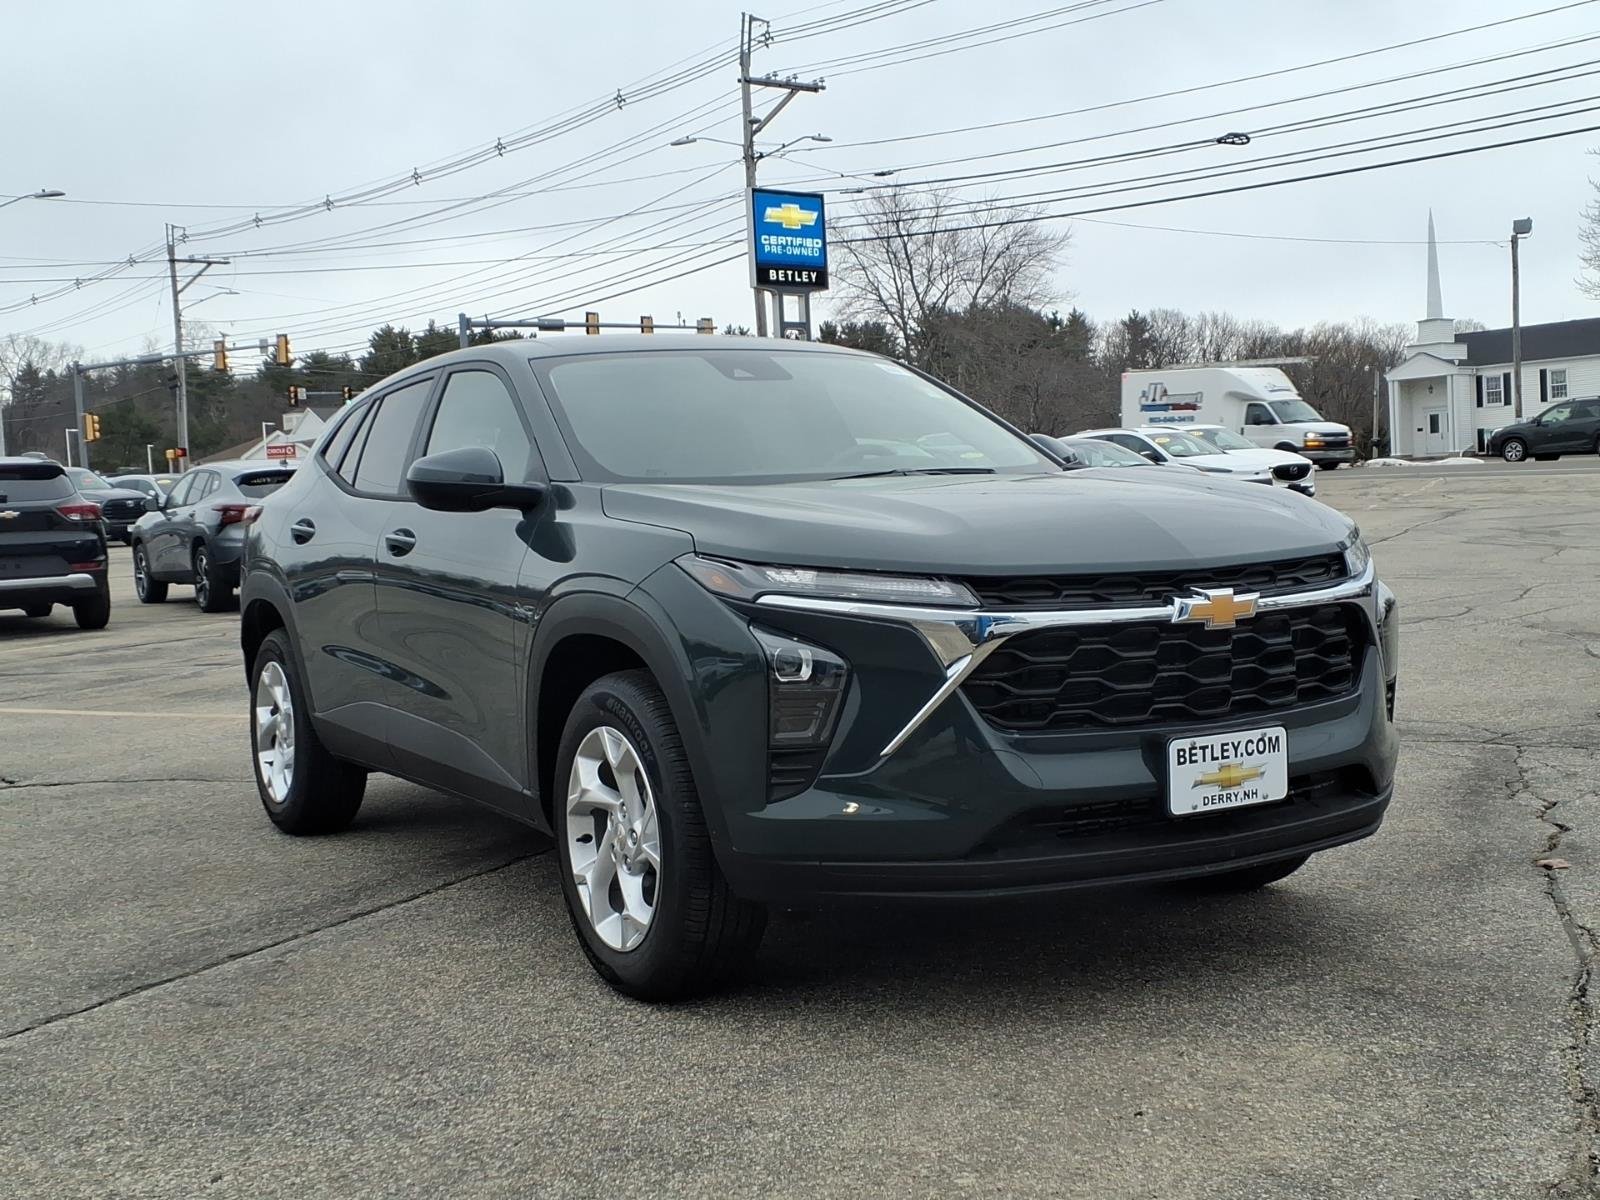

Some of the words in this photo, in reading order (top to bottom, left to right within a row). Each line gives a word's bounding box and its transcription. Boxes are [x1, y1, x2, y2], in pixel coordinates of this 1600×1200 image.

[761, 235, 822, 248] CERTIFIED
[764, 244, 820, 256] PRE-OWNED
[769, 269, 817, 283] BETLEY
[1176, 735, 1280, 766] BETLEY.COM
